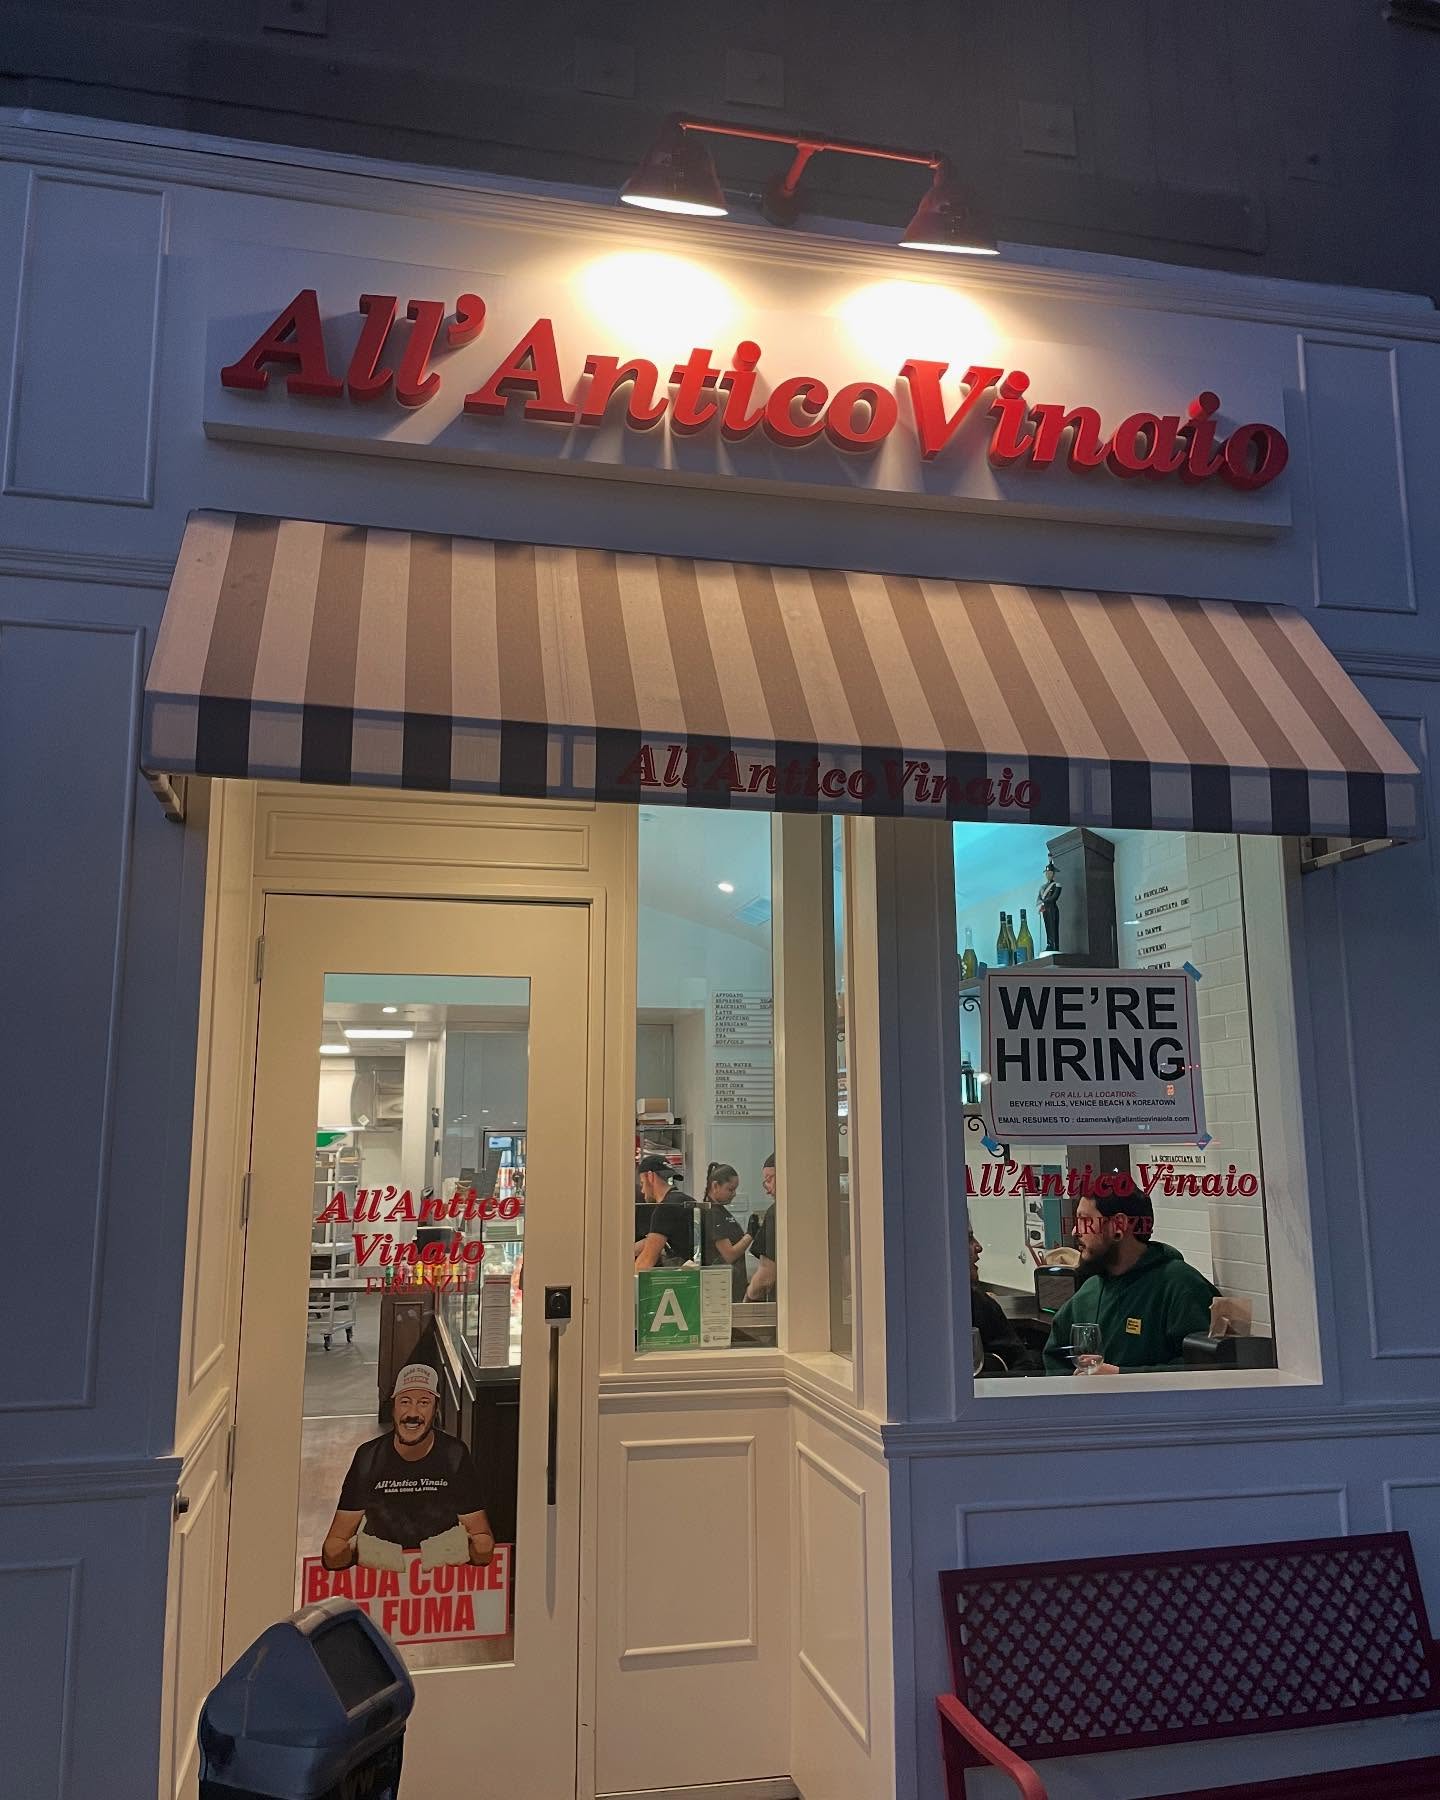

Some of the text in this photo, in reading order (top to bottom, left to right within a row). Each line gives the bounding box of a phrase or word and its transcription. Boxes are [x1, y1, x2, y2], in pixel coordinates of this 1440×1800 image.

[898, 358, 1290, 491] Vinaio
[616, 743, 1041, 809] All'Antico Vinaio
[998, 986, 1178, 1030] WE'RE
[996, 1036, 1187, 1082] HIRING
[1009, 1100, 1043, 1108] BEVERLY
[1098, 1099, 1125, 1107] BEACH
[1132, 1099, 1176, 1107] KOREATOWN
[1050, 1091, 1067, 1099] FOR
[1067, 1091, 1083, 1099] ALL
[1083, 1091, 1095, 1099] LA
[998, 1116, 1021, 1124] EMAIL
[1022, 1116, 1058, 1124] RESUMES
[1058, 1116, 1070, 1124] TO
[1136, 1163, 1259, 1198] Vinaio
[315, 1185, 522, 1224] All'Antico
[351, 1231, 486, 1267] Vinaio
[364, 1274, 469, 1297] FIRENZE
[649, 1288, 689, 1332] A
[419, 1478, 448, 1487] Vinaio
[307, 1553, 504, 1603] BADA COME
[382, 1594, 475, 1637] FUMA
